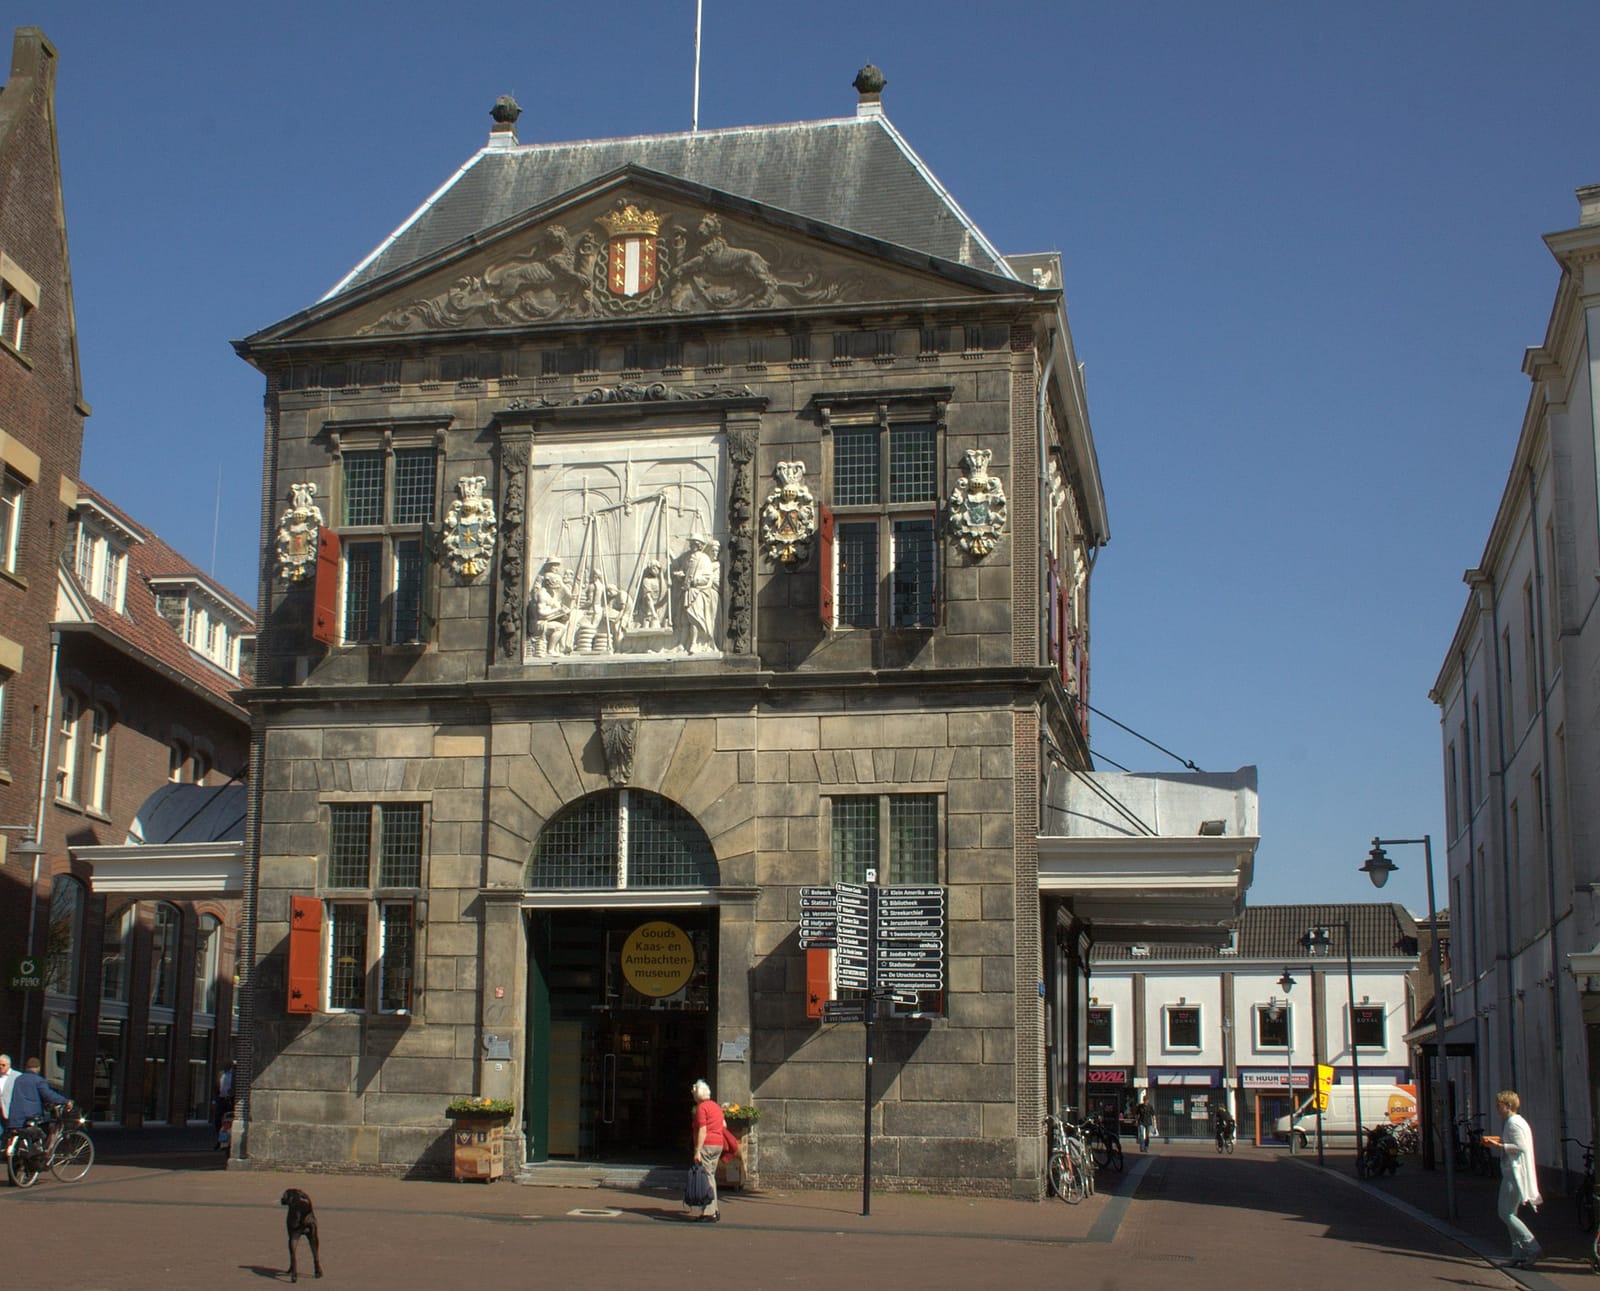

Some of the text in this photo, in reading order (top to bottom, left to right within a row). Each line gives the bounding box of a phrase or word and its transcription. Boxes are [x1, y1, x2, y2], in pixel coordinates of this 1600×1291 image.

[890, 919, 929, 927] Jeruzalemkapel
[641, 928, 676, 938] Gouds
[635, 942, 681, 951] Kaas- en
[625, 954, 691, 965] Ambachten-
[635, 969, 681, 978] museum
